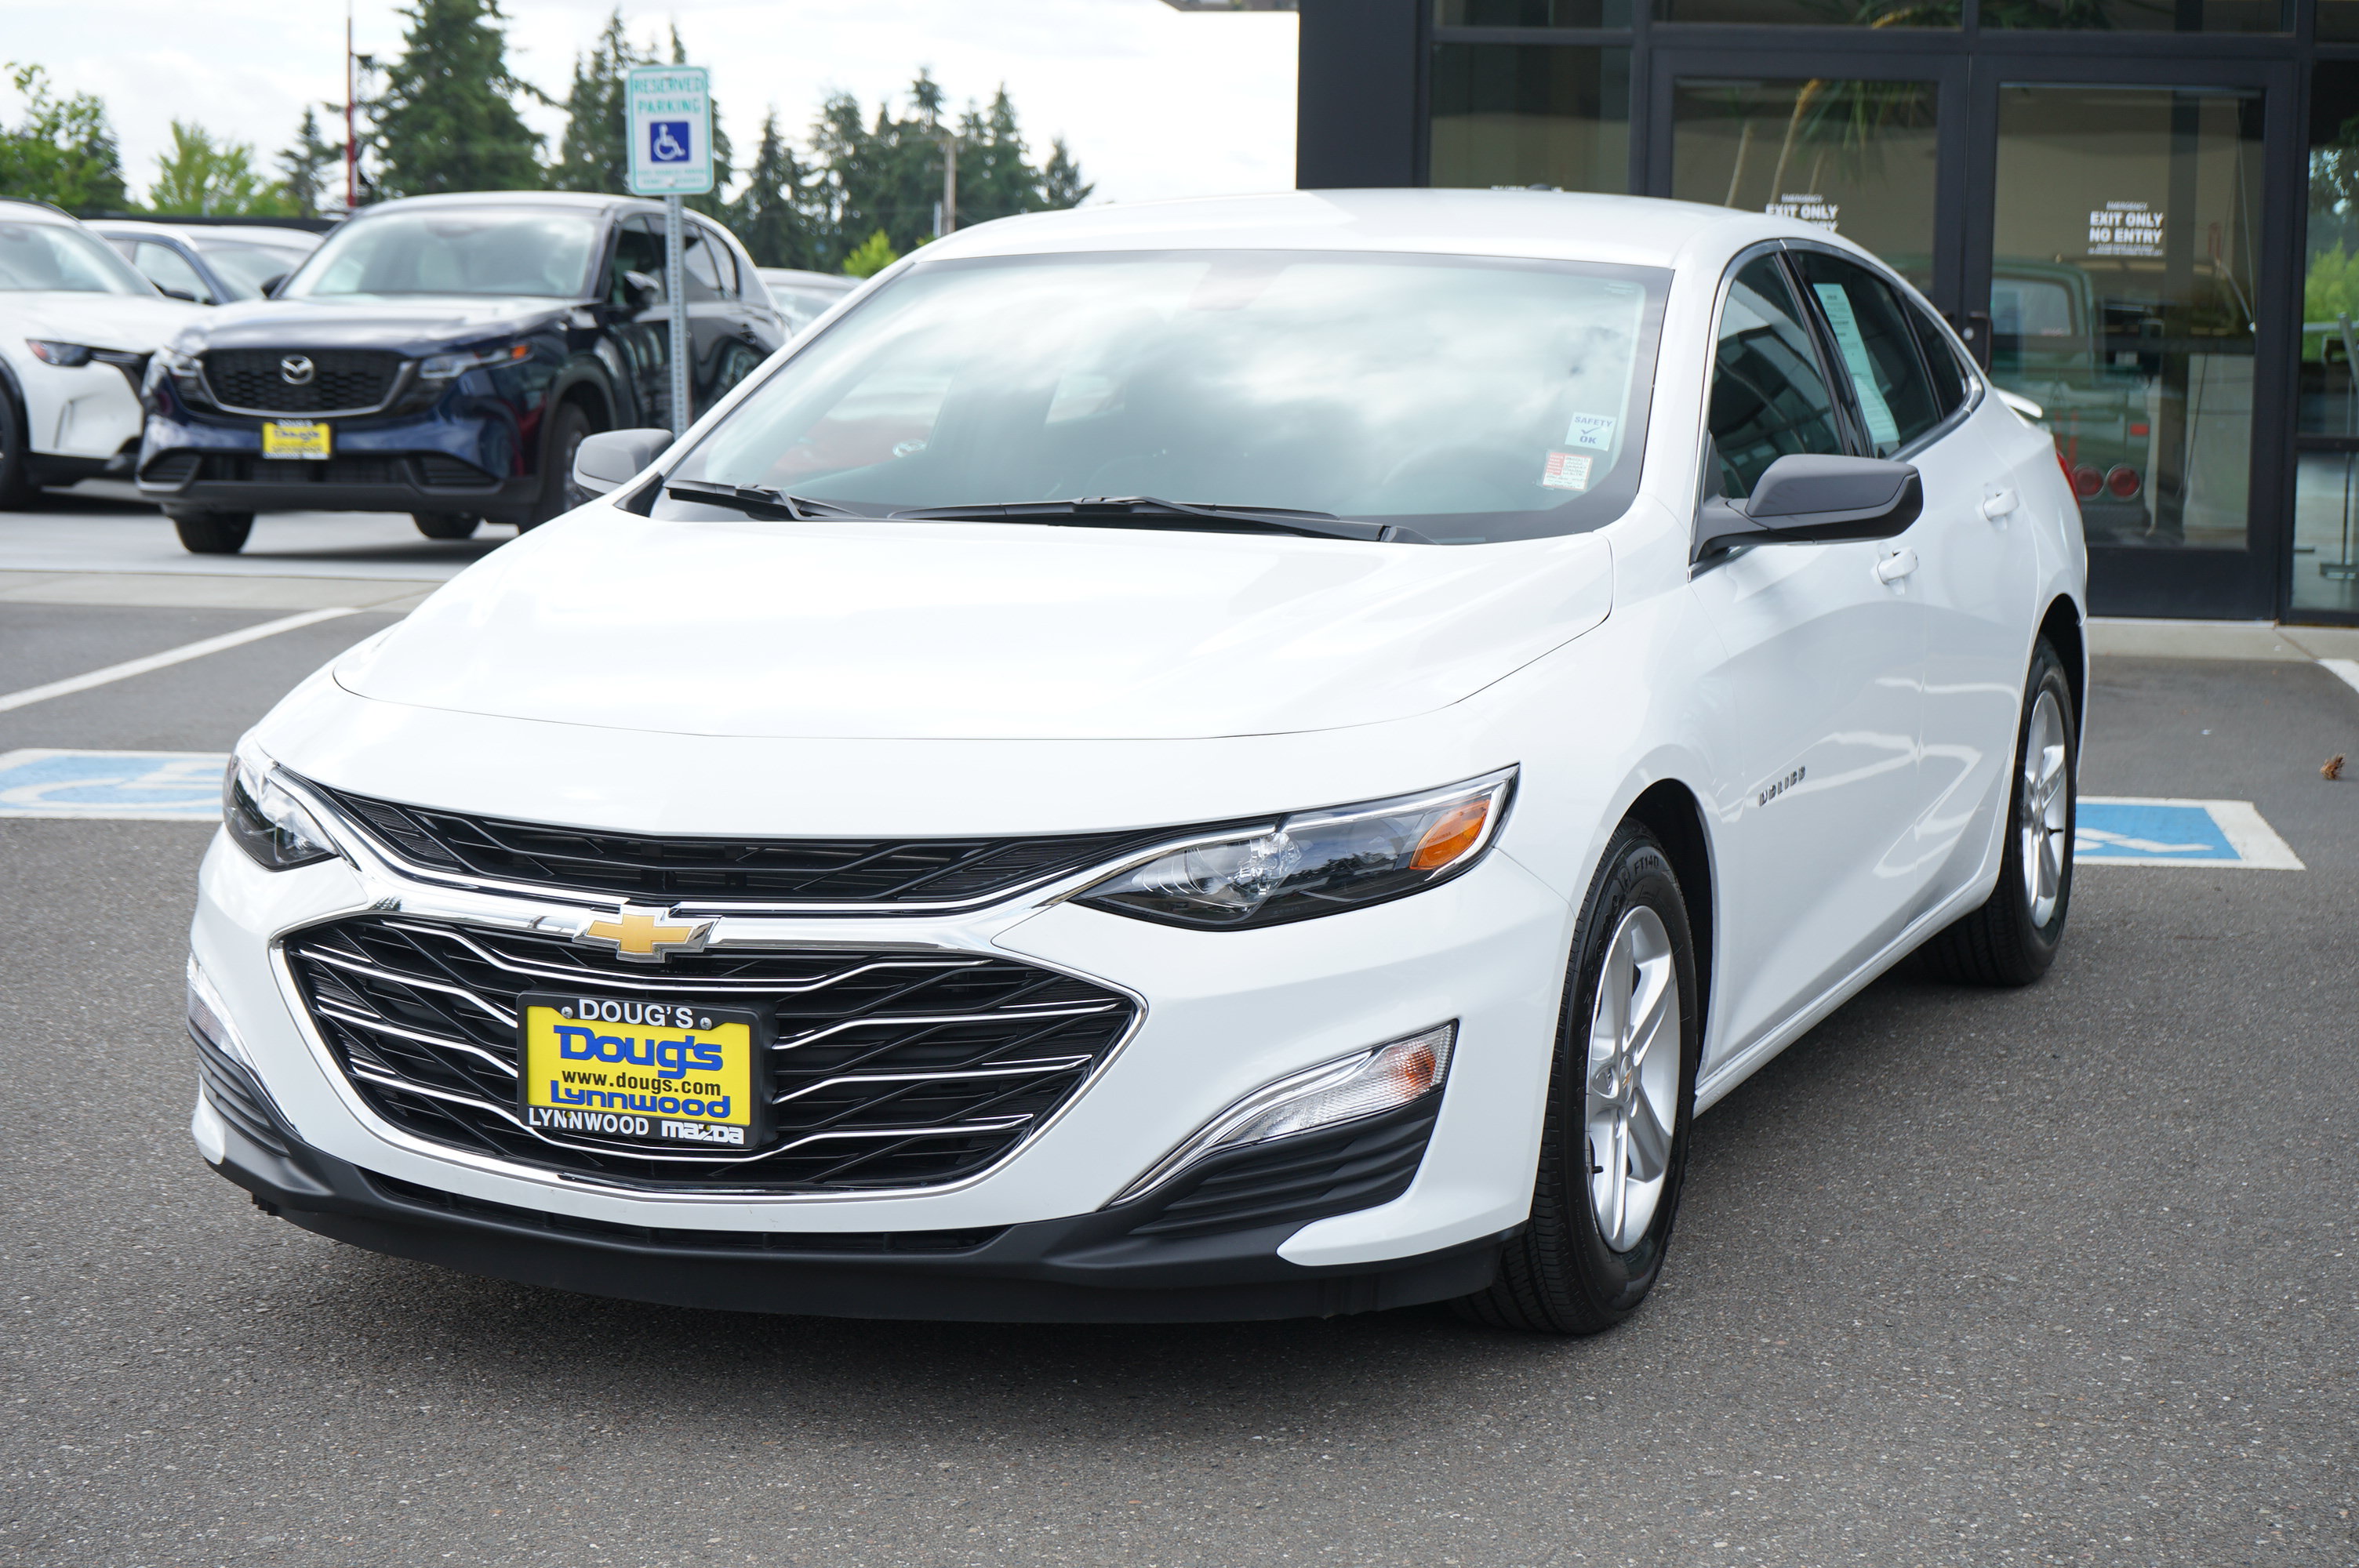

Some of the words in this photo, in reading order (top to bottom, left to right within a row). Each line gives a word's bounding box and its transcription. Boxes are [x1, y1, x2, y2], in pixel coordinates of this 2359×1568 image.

[633, 77, 707, 93] RESERVED
[638, 98, 701, 113] PARKING
[1765, 204, 1798, 218] EXIT
[1800, 204, 1839, 220] ONLY
[2090, 211, 2123, 226] EXIT
[2125, 212, 2164, 227] ONLY
[2089, 227, 2112, 242] NO
[2114, 227, 2163, 244] ENTRY
[1574, 416, 1613, 427] SAFETY
[1579, 435, 1597, 444] OK
[579, 999, 693, 1029] DOUG'S
[553, 1025, 723, 1080] Doug's
[562, 1070, 721, 1096] www.dougs.com
[551, 1080, 730, 1118] Lynnwood
[529, 1107, 649, 1135] LYNNWOOD
